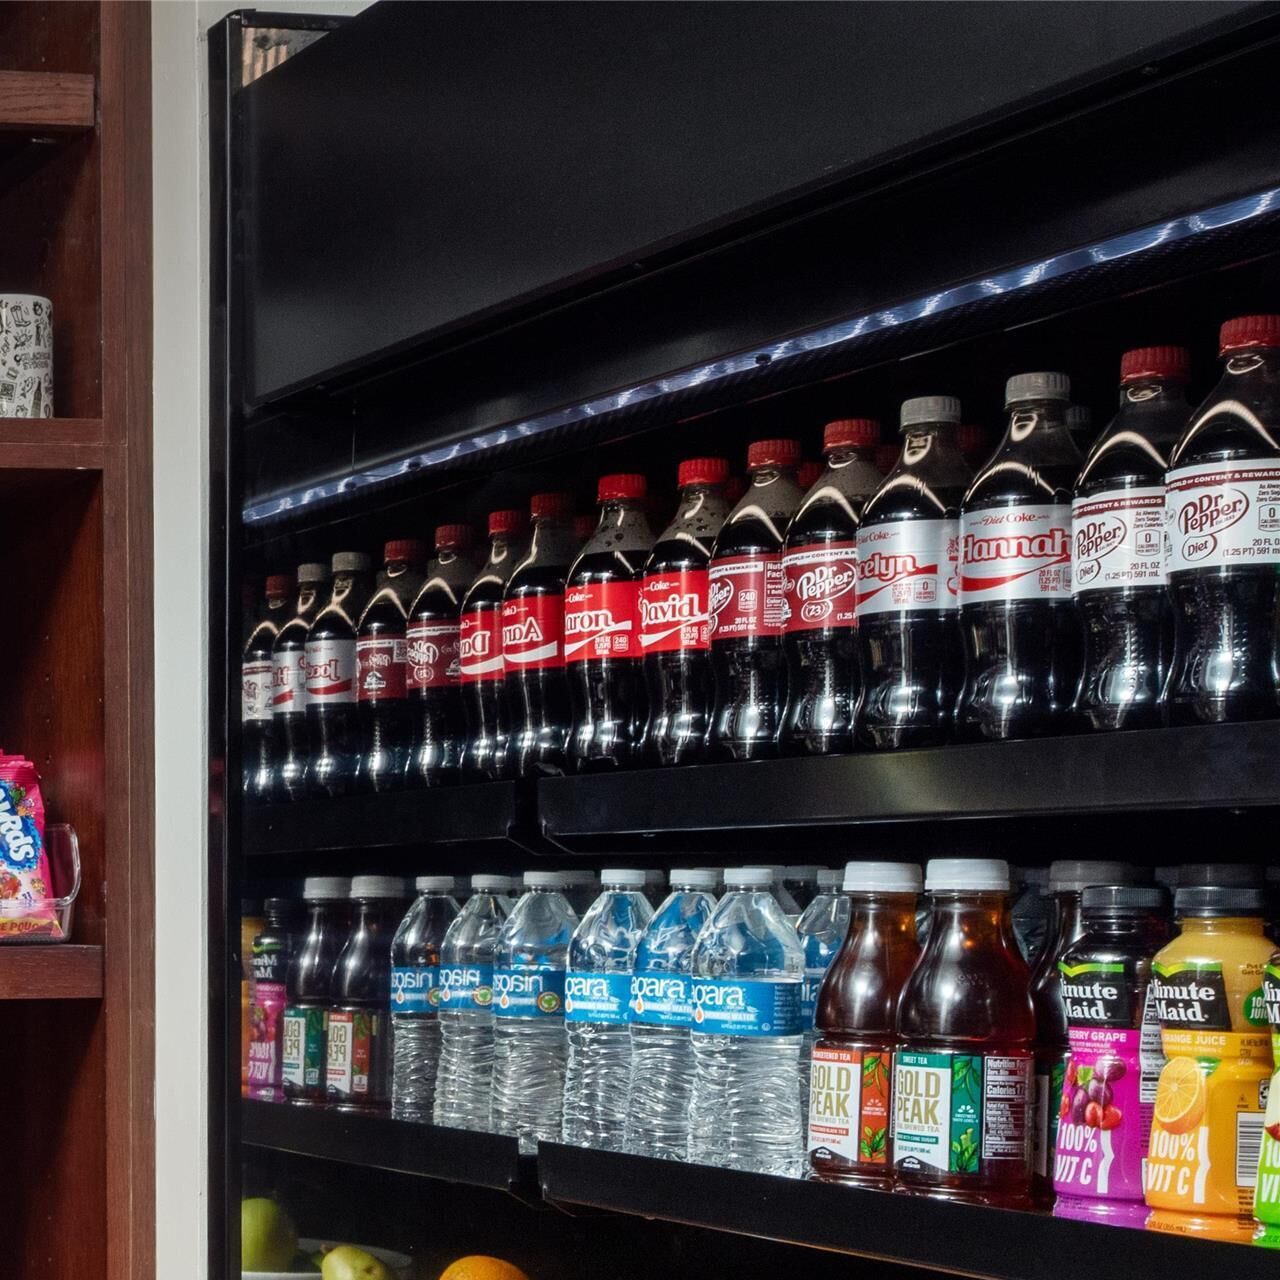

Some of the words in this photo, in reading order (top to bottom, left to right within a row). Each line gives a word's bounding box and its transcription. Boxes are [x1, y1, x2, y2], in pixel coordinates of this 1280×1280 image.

[1195, 474, 1232, 483] CONTENT
[1084, 503, 1112, 511] CONTENT
[1199, 494, 1223, 514] Dr
[983, 514, 1005, 526] Diet
[1006, 513, 1036, 524] Coke
[1180, 499, 1242, 535] Pepper
[869, 532, 890, 541] Coke
[1087, 522, 1105, 541] Dr
[1145, 533, 1151, 543] 0
[961, 528, 1072, 564] Hannah
[1077, 527, 1121, 560] Pepper
[1188, 541, 1208, 557] Diet
[815, 566, 837, 584] Dr
[857, 553, 917, 581] celyn
[1080, 565, 1094, 580] Diet
[1105, 572, 1120, 580] (1.25
[650, 580, 670, 591] Coke
[803, 570, 852, 600] Pepper
[741, 593, 754, 601] 240
[642, 594, 704, 624] David
[809, 605, 822, 616] 23
[565, 610, 614, 634] aron
[631, 975, 685, 999] agara
[1091, 1032, 1127, 1042] GRAPE
[1196, 1036, 1226, 1045] JUICE
[988, 1059, 1015, 1069] Nutrition
[811, 1065, 851, 1091] GOLD
[898, 1069, 940, 1098] GOLD
[987, 1086, 1015, 1095] Calories
[811, 1092, 849, 1118] PEAK
[897, 1098, 940, 1126] PEAK
[1059, 1125, 1097, 1153] 100%
[1151, 1130, 1196, 1161] 100%
[1147, 1162, 1173, 1191] VIT
[1178, 1166, 1191, 1195] C
